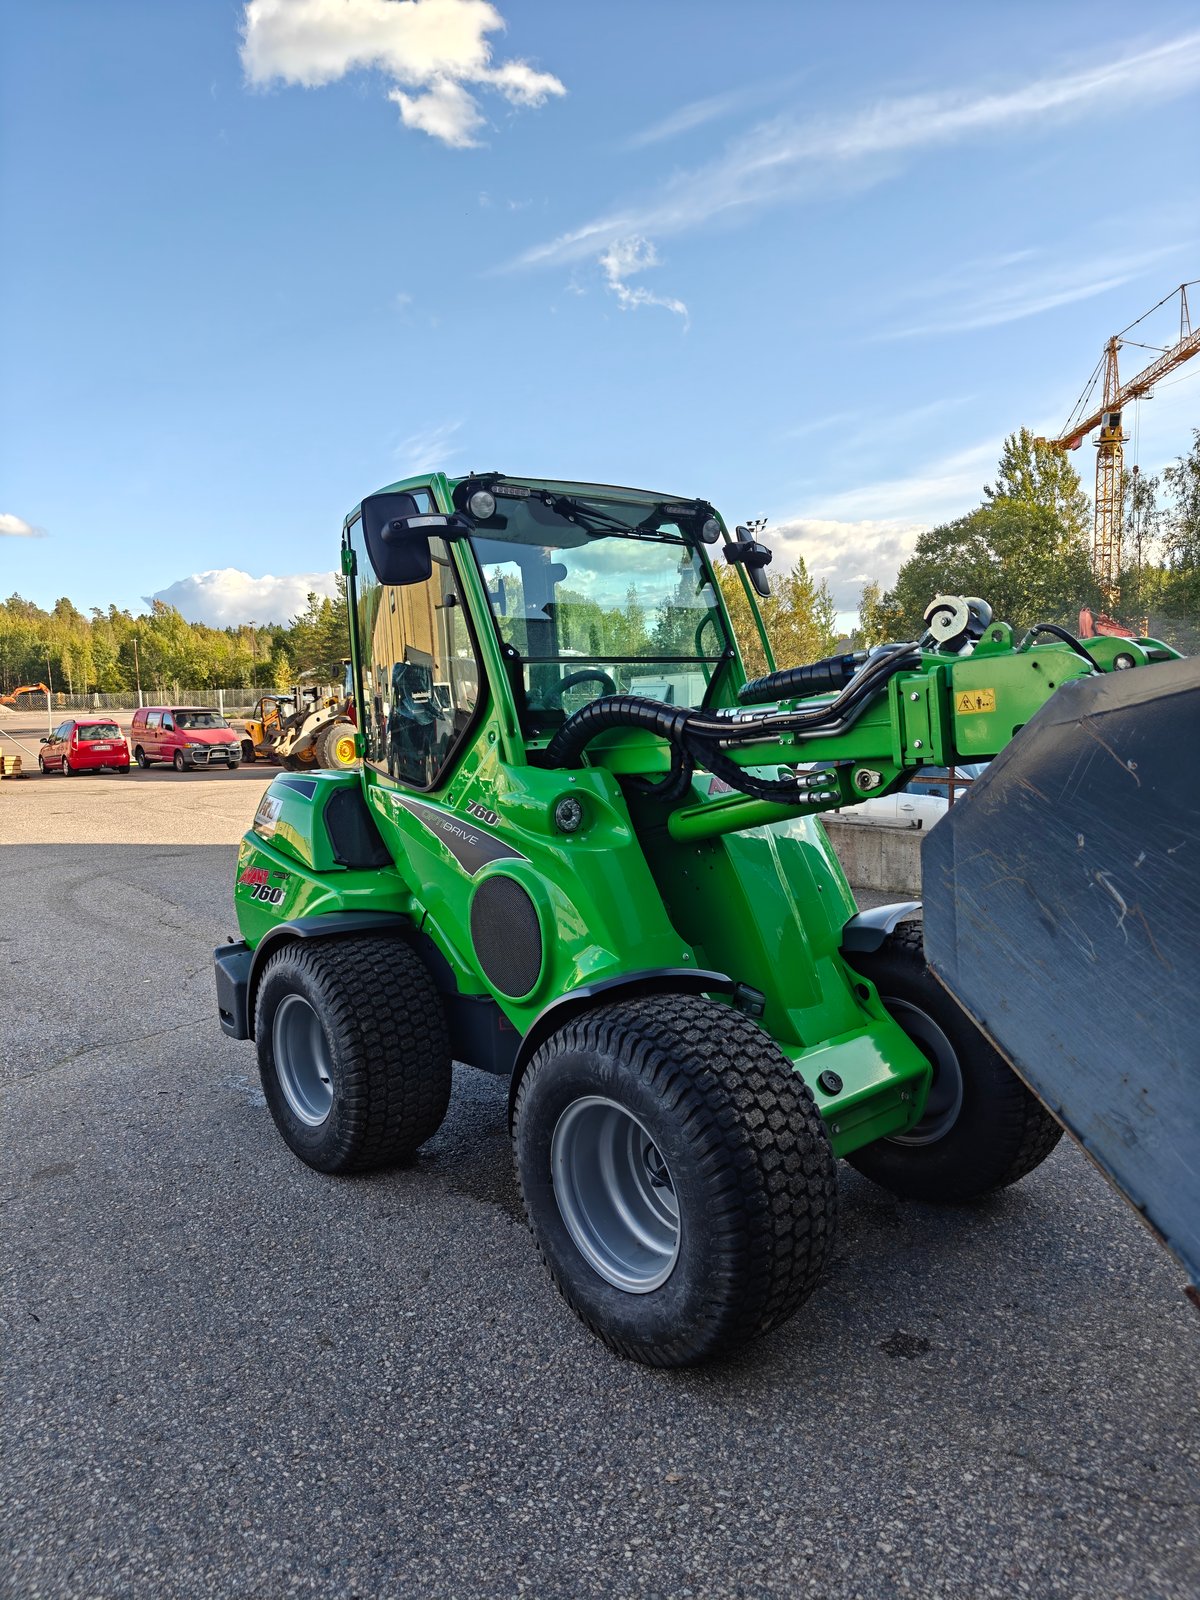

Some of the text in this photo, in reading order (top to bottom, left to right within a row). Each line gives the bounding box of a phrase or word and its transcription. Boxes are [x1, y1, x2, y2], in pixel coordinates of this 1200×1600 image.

[421, 809, 480, 845] OPTIDRIVE
[465, 799, 503, 828] 760i
[250, 882, 287, 906] 760i
